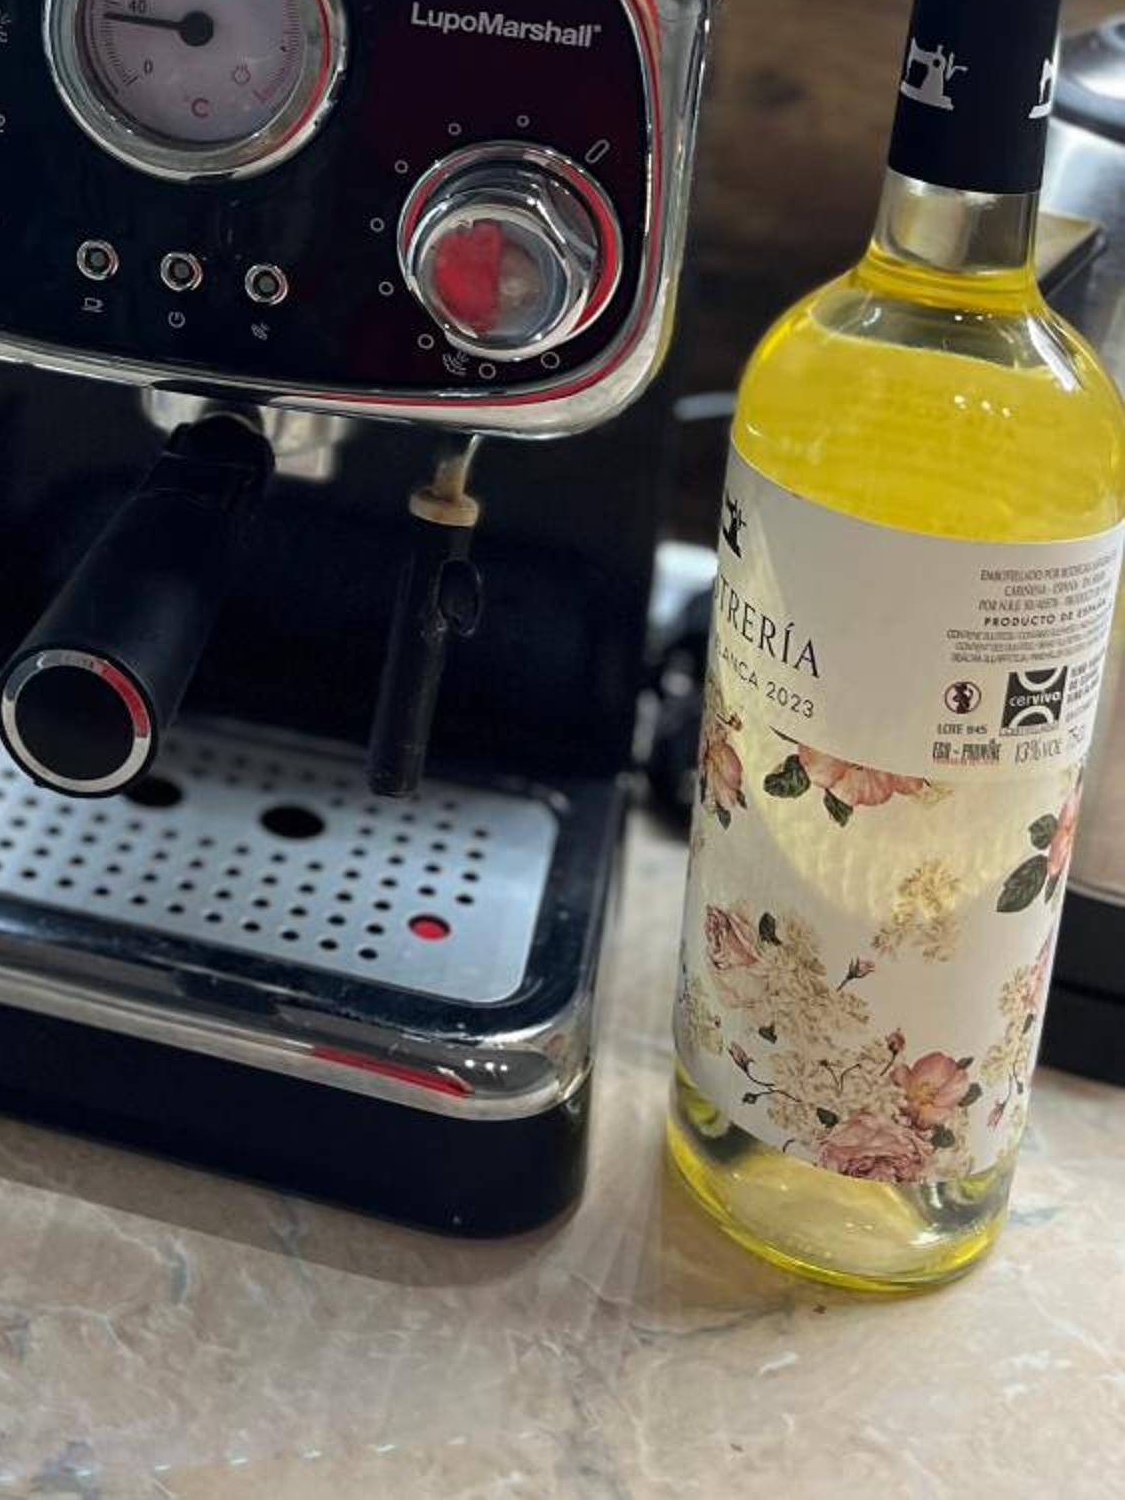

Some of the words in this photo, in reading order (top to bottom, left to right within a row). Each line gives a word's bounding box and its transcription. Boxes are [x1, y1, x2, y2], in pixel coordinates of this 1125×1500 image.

[129, 0, 147, 13] 40
[143, 59, 153, 74] 0
[715, 573, 820, 679] TRERÍA
[984, 614, 1056, 628] PRODUCTO
[1060, 611, 1074, 622] DE
[765, 681, 815, 719] 2023
[937, 723, 963, 735] LOTE
